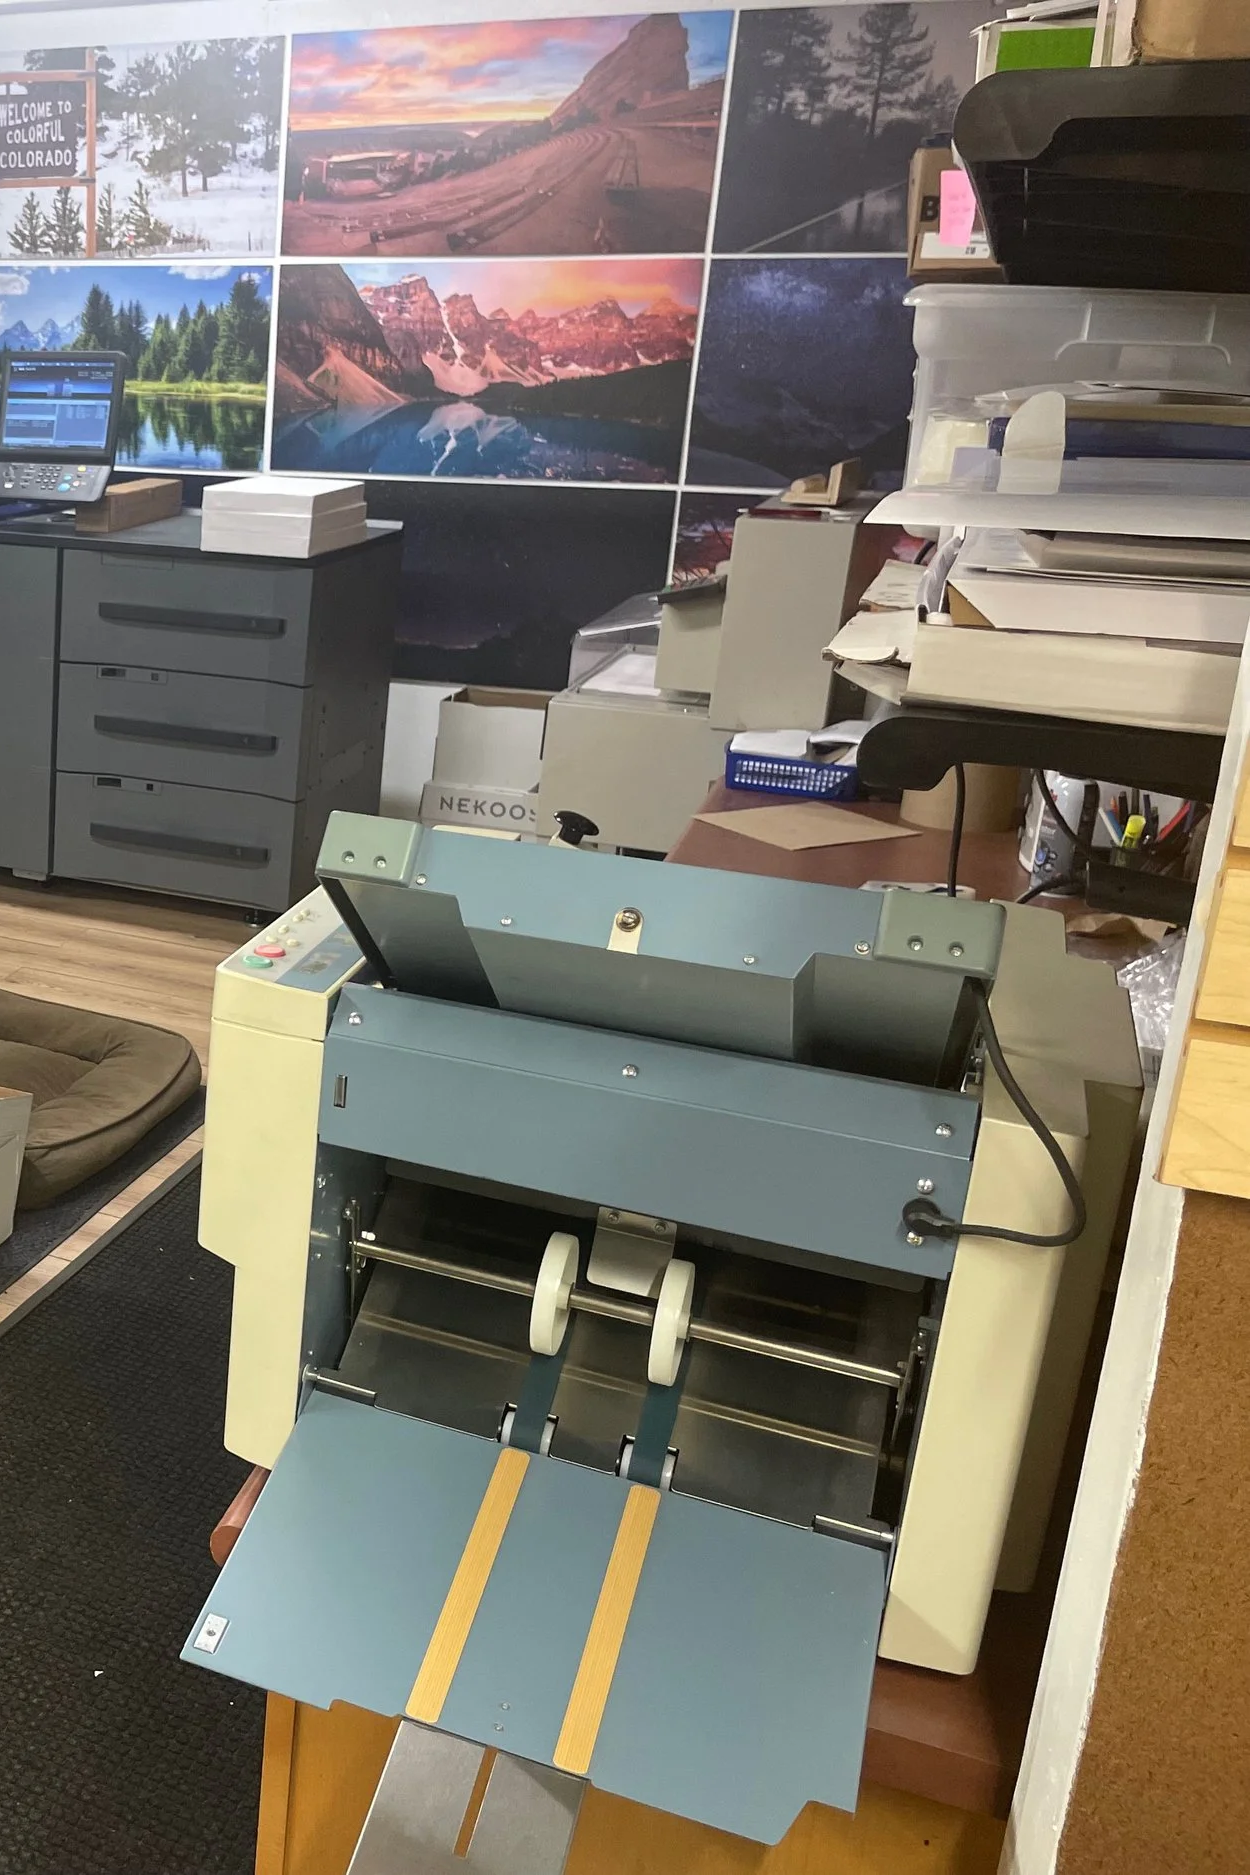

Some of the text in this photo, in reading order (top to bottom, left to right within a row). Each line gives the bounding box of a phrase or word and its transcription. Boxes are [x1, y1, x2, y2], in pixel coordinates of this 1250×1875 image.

[58, 100, 72, 114] TO
[6, 119, 65, 144] COLORFUL
[0, 149, 72, 169] COLORADO
